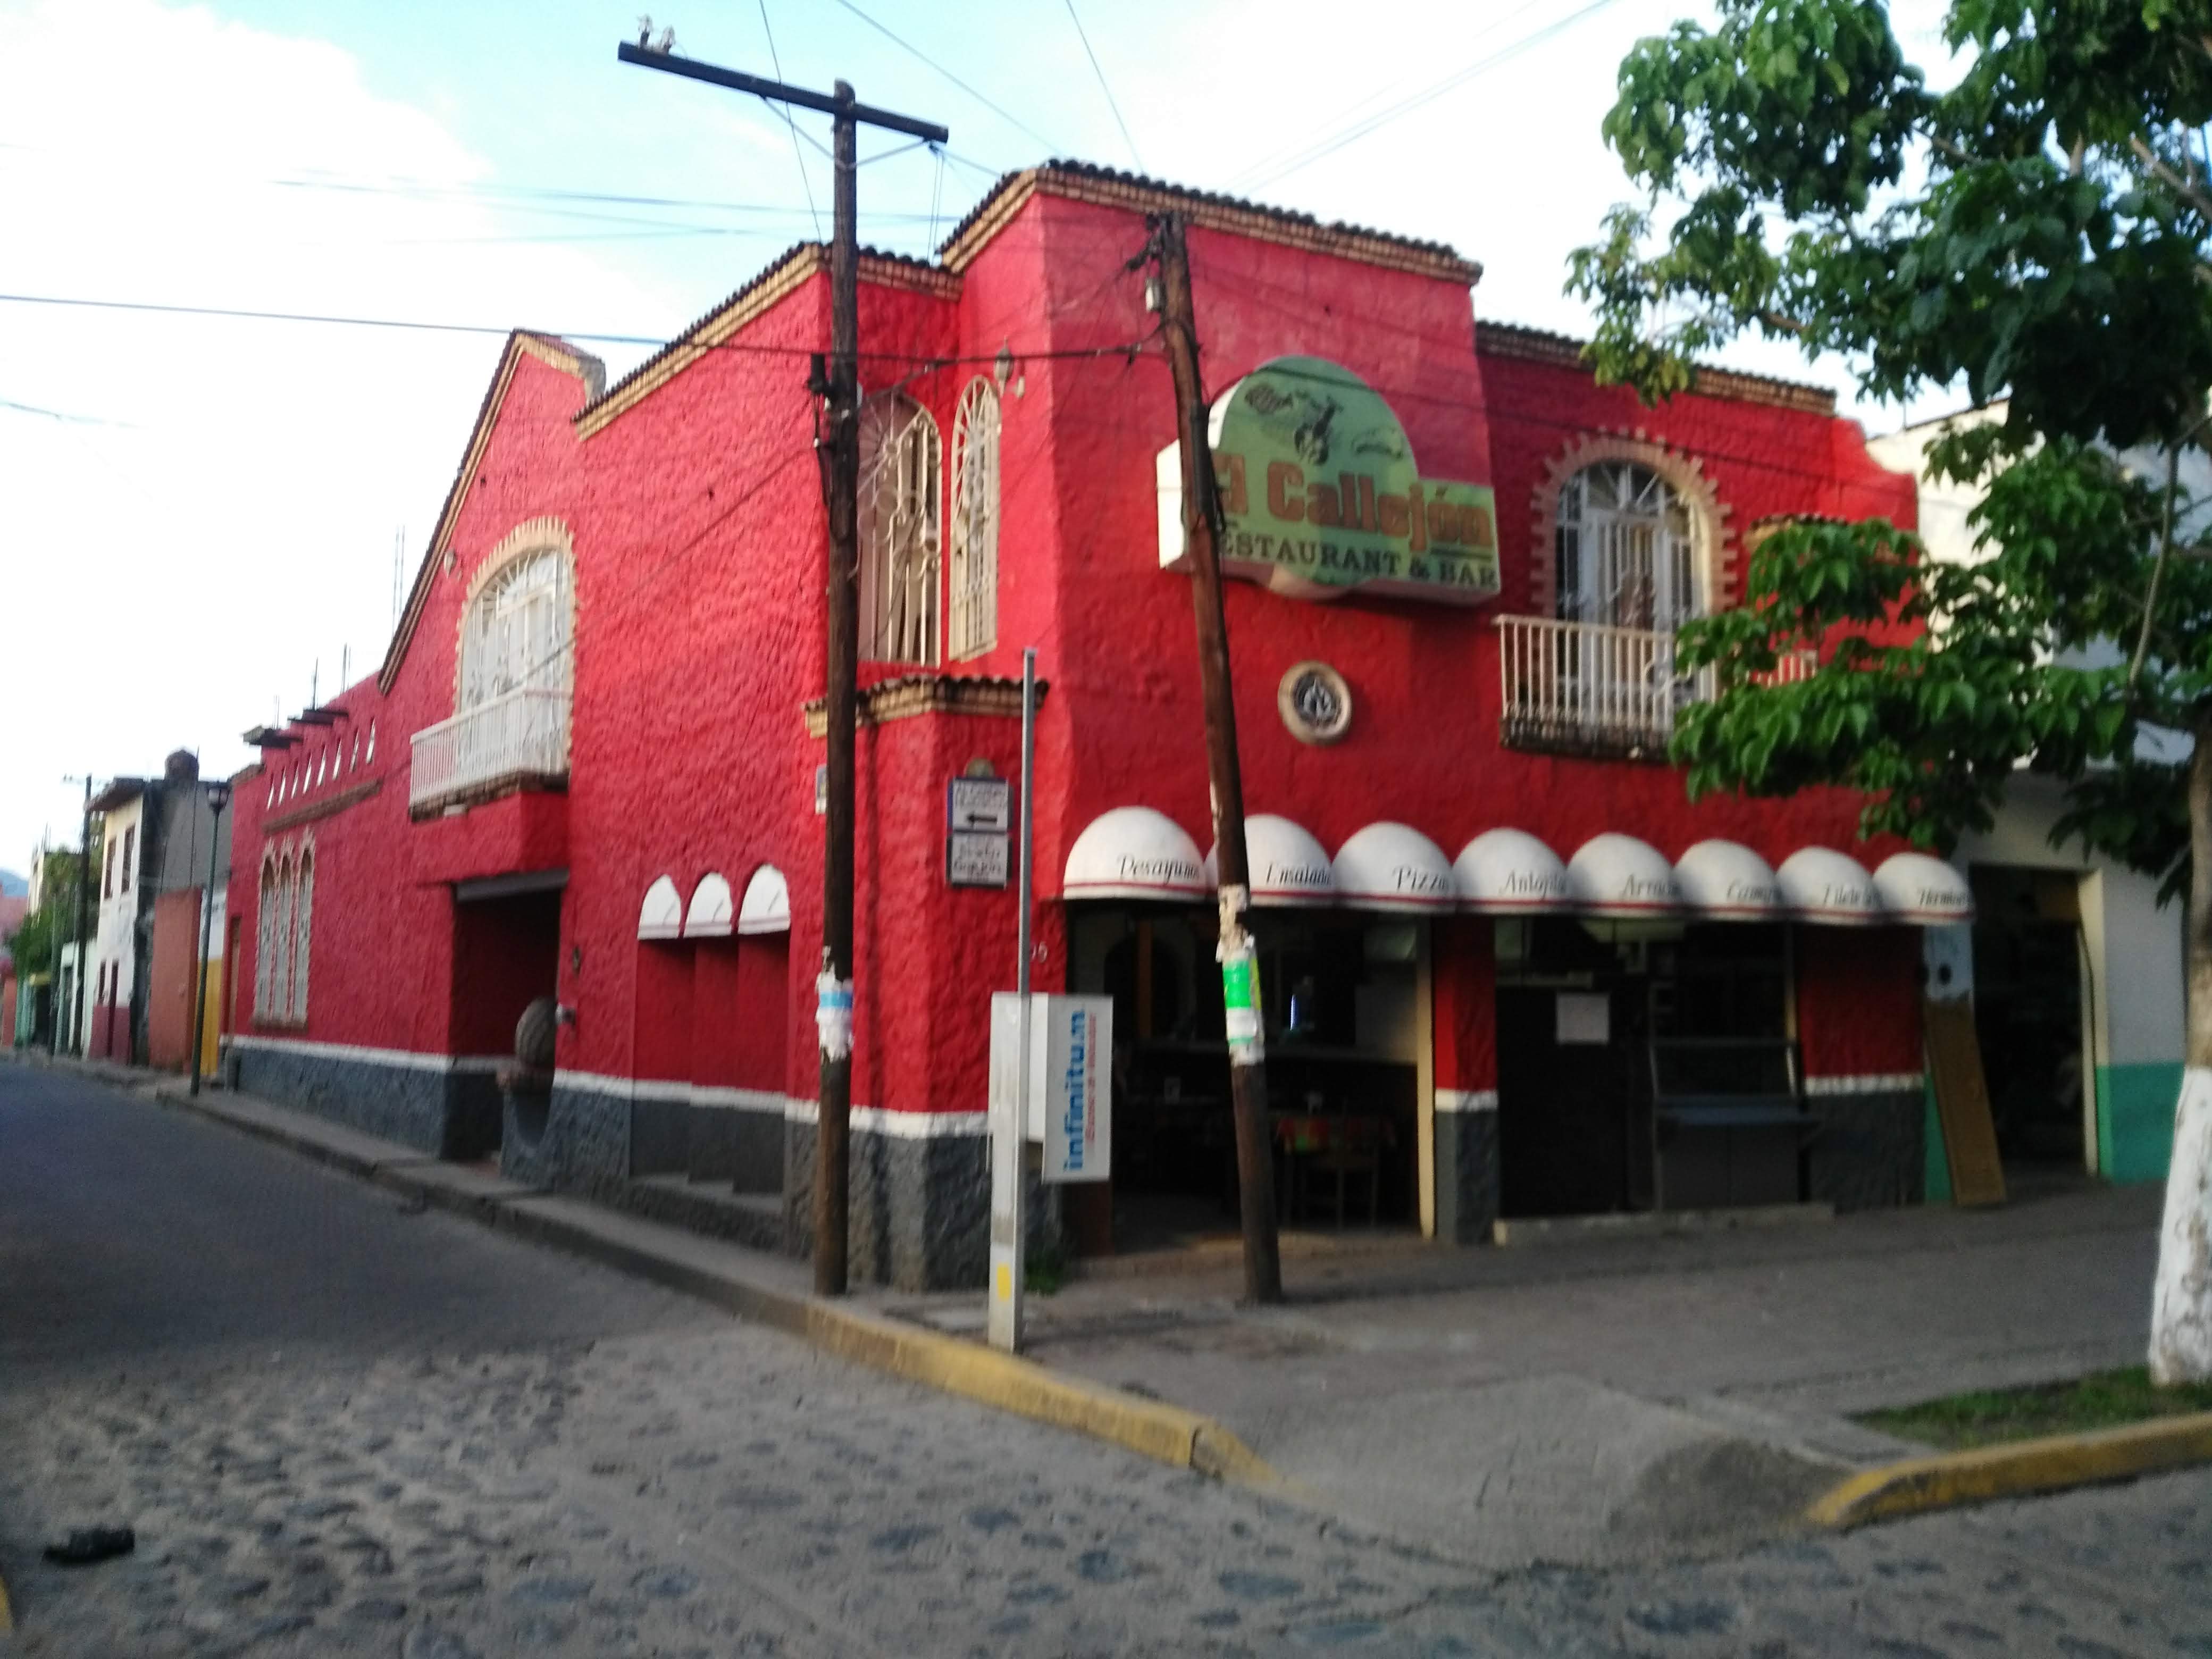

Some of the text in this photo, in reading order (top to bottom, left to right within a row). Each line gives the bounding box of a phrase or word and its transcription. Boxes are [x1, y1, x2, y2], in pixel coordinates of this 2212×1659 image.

[1267, 459, 1493, 552] Callejón
[1219, 531, 1496, 589] ESTAURANT & BAR
